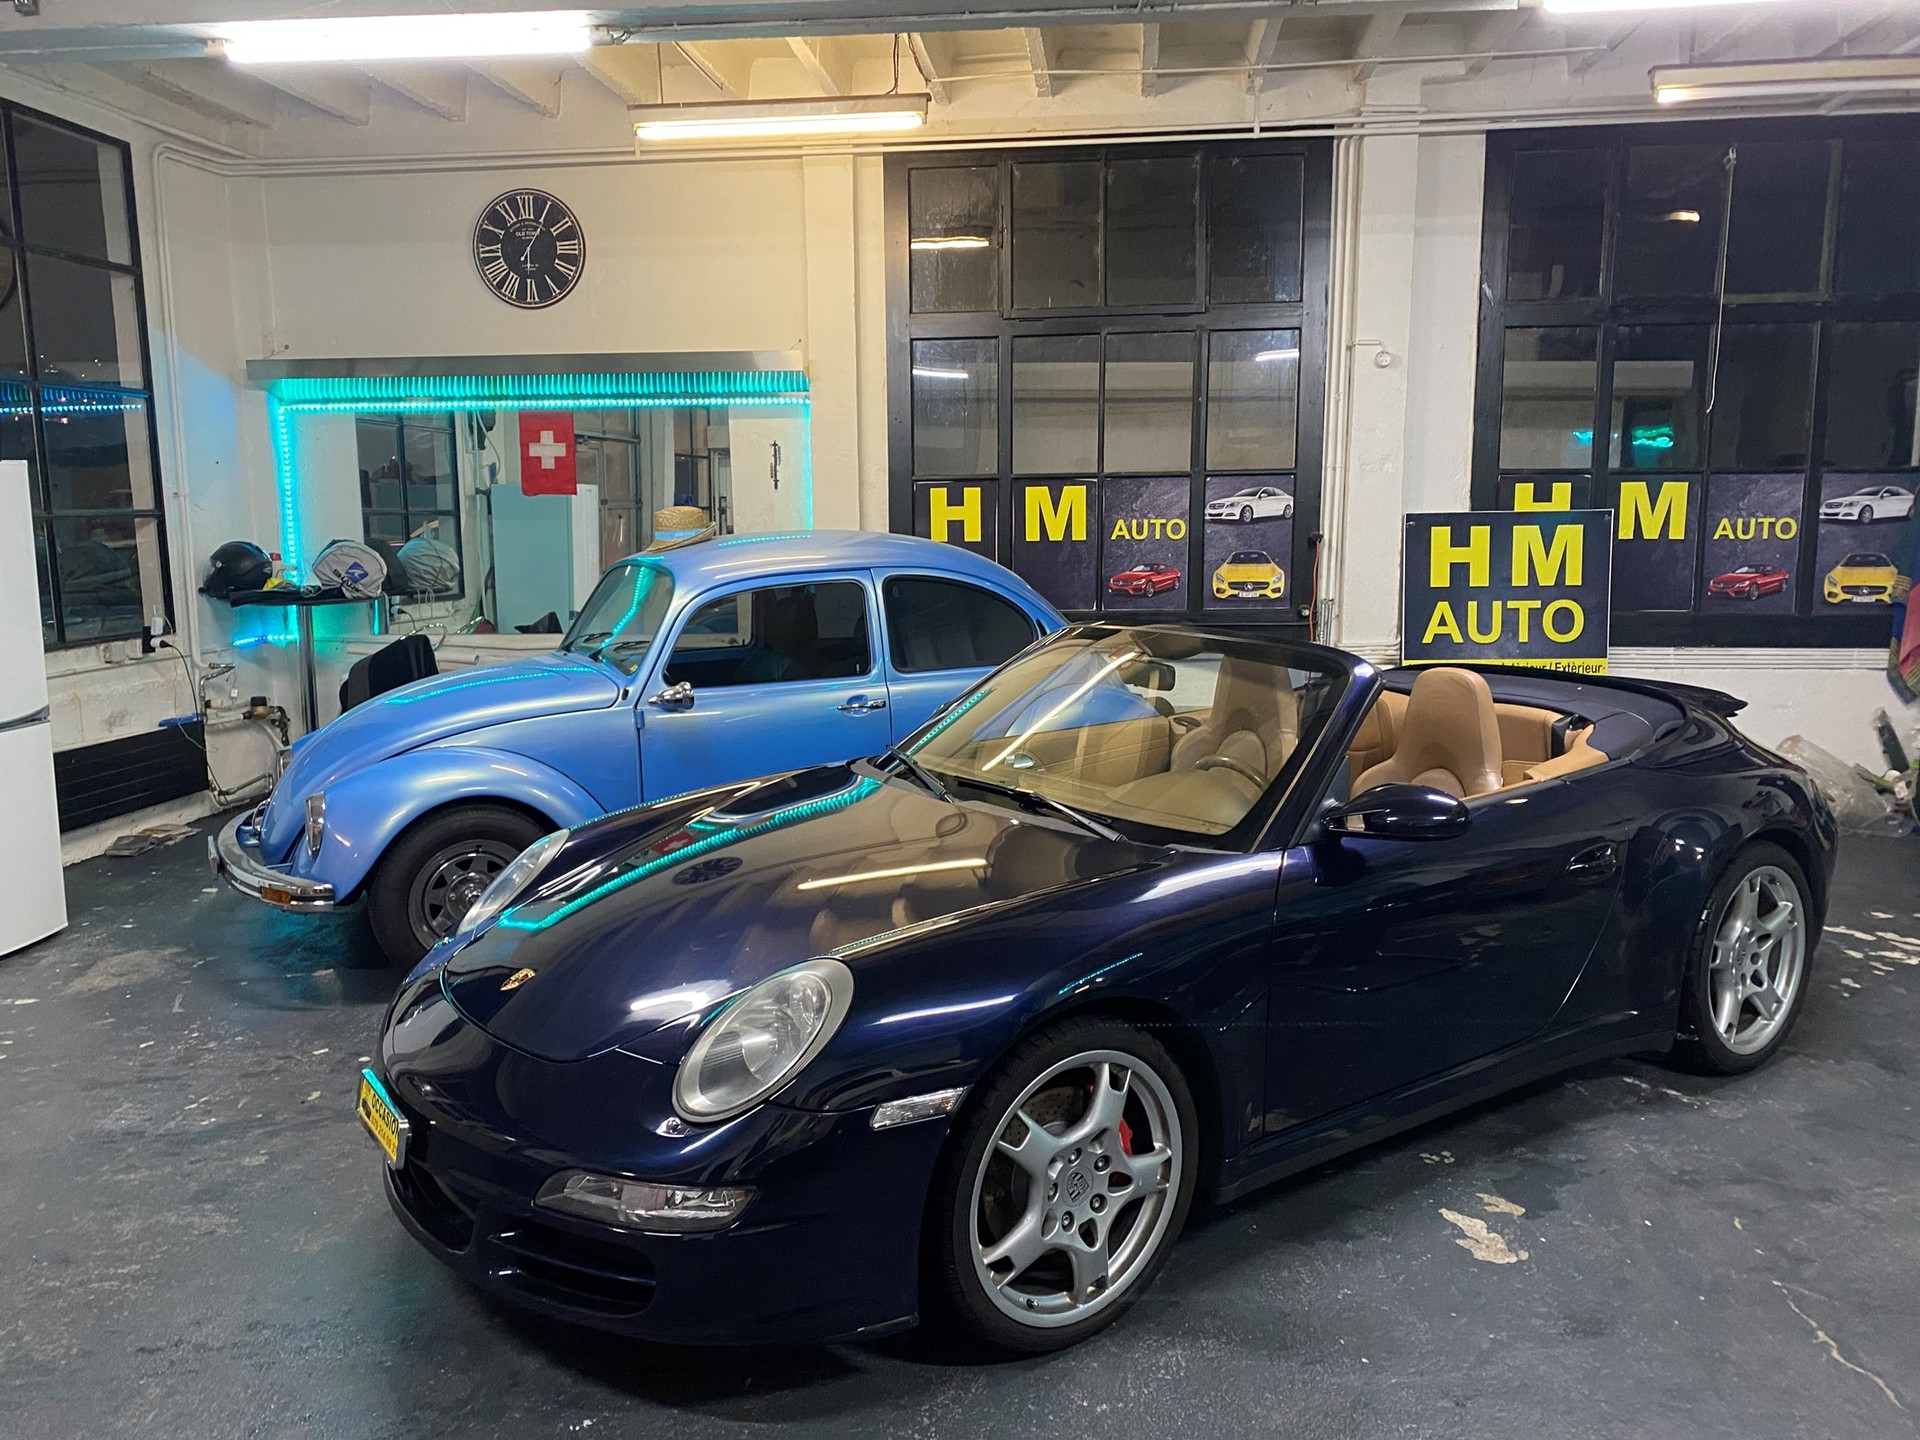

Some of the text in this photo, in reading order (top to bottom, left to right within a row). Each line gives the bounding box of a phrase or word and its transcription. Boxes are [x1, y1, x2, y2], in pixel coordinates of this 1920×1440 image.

[516, 195, 535, 220] XII
[1110, 518, 1187, 541] AUTO
[1713, 517, 1798, 541] AUTO
[1421, 599, 1586, 644] AUTO
